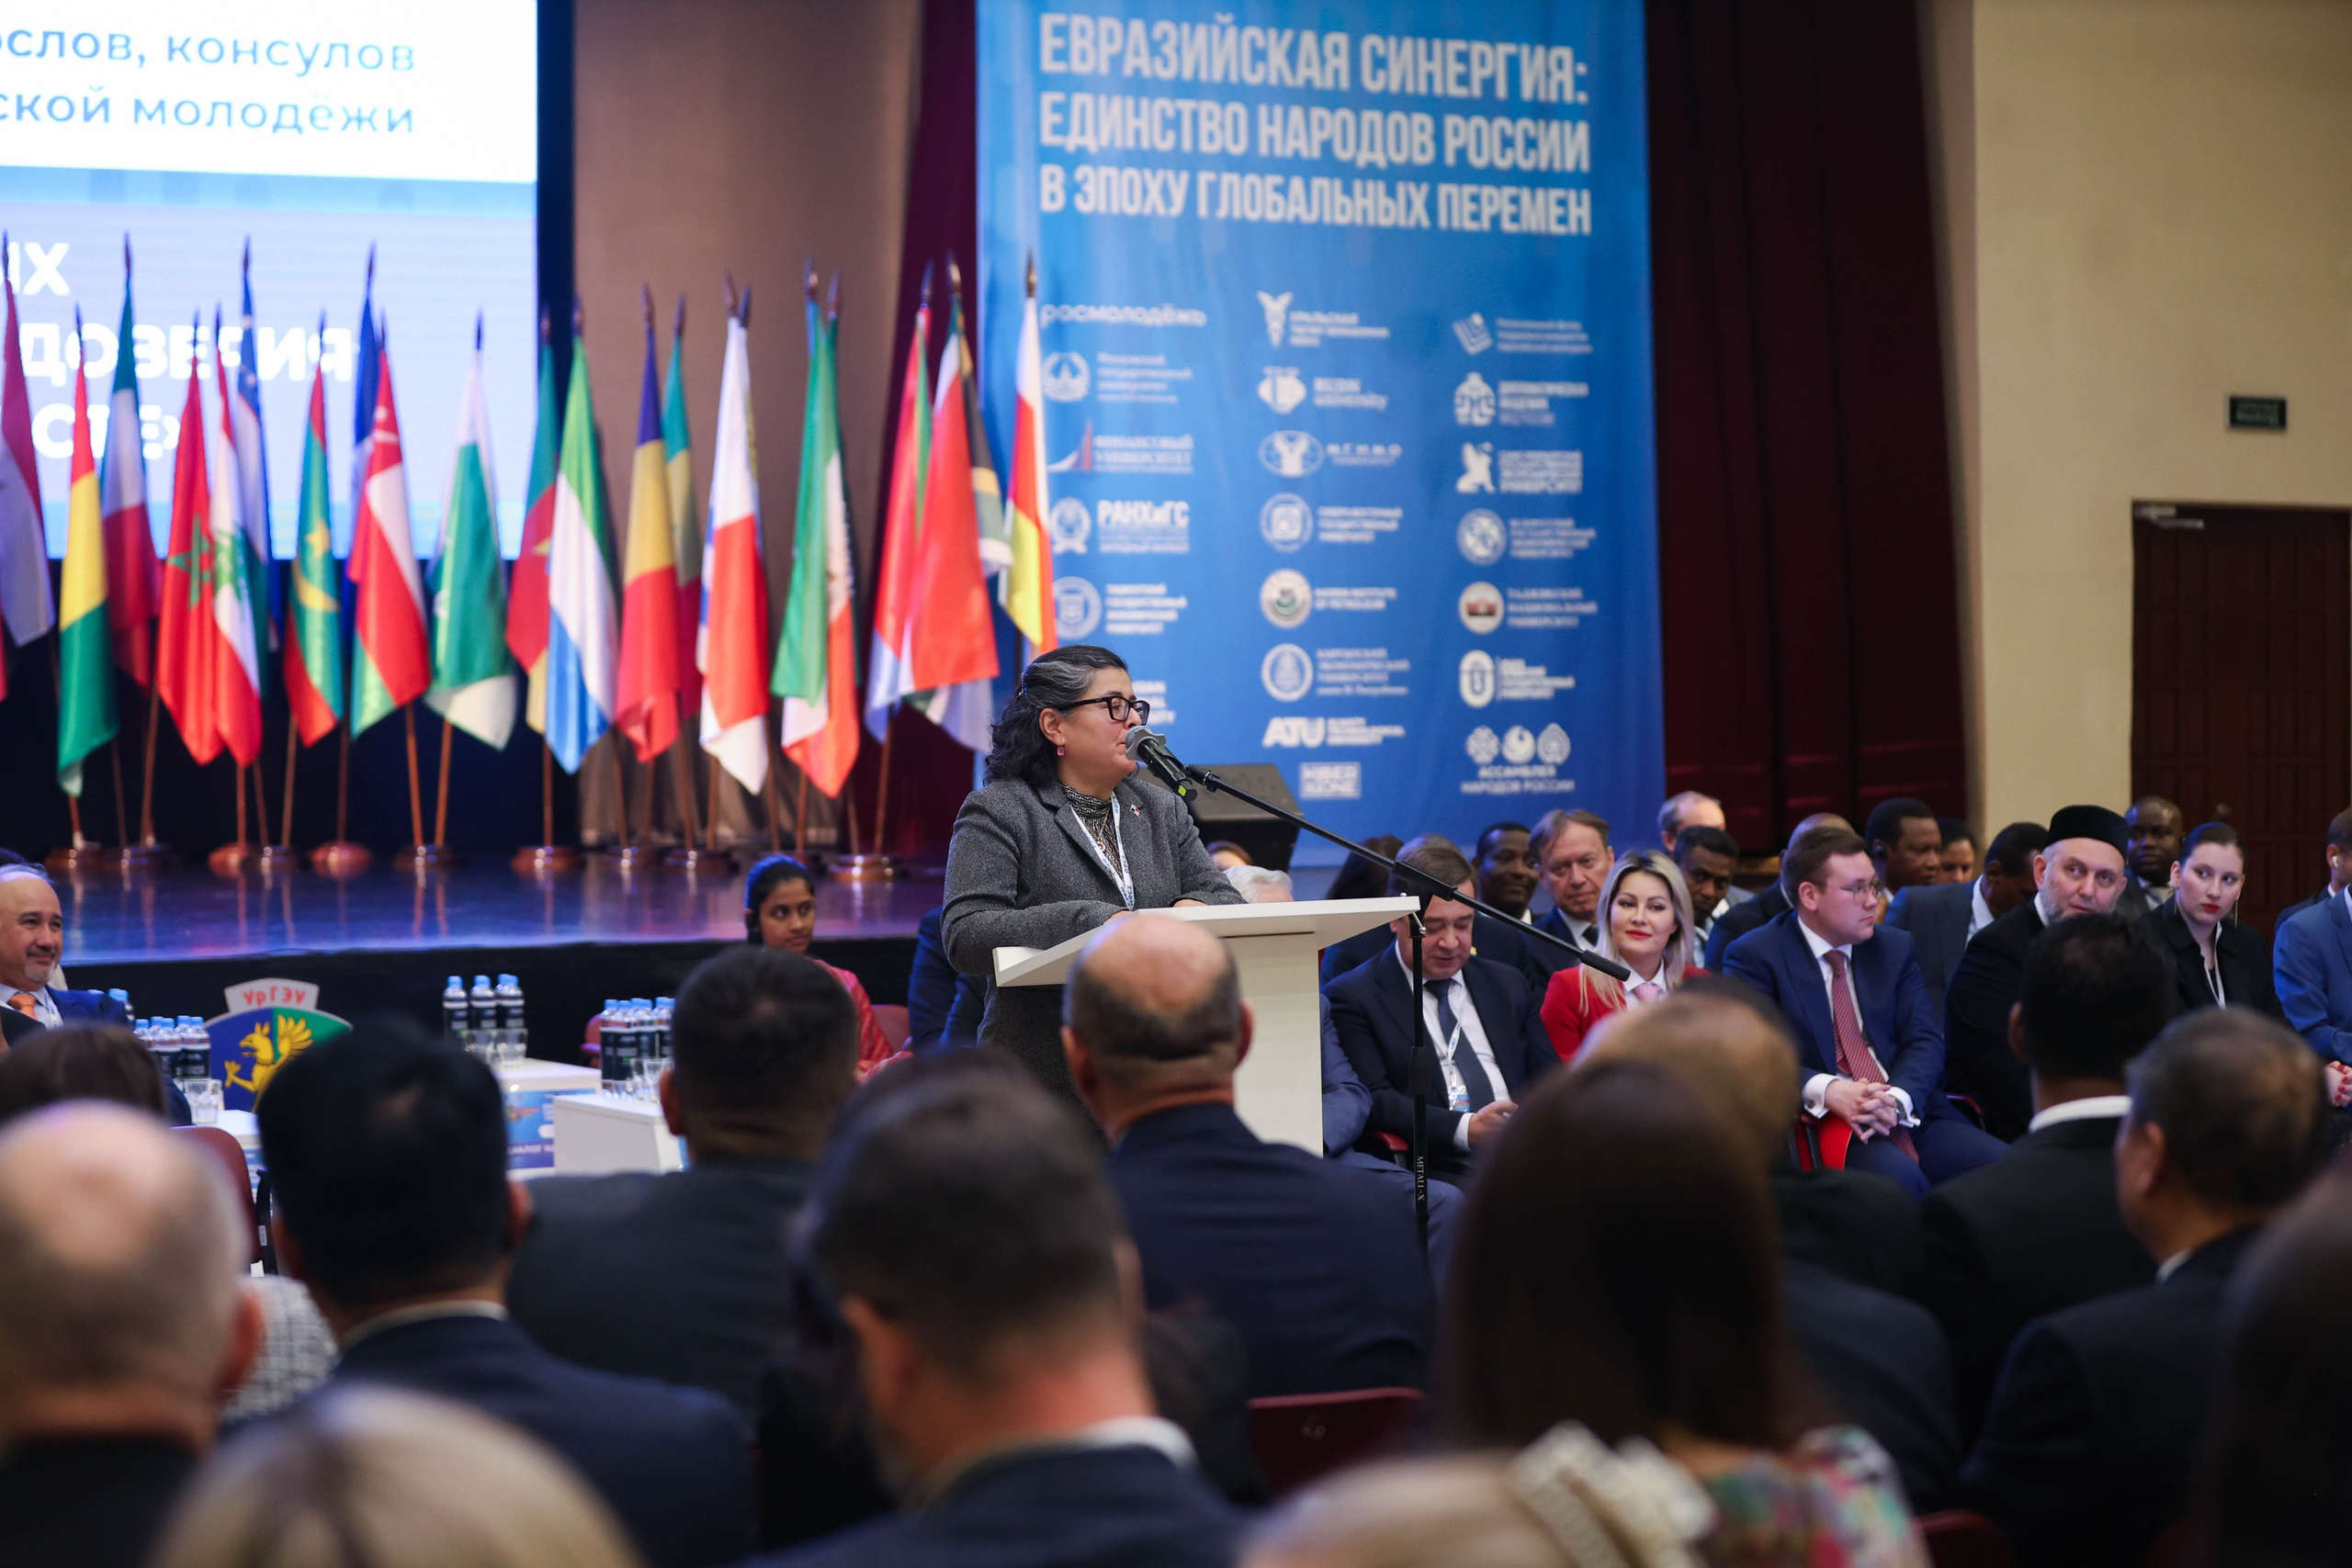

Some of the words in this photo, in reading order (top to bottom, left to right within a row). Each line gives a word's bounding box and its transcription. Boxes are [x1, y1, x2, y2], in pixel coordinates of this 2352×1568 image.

[0, 29, 145, 69] слов,
[166, 35, 415, 77] консулов
[1040, 13, 1351, 90] ЕВРАЗИЙСКАЯ
[1361, 34, 1589, 104] СИНЕРГИЯ:
[133, 94, 415, 135] молодёжи
[1040, 91, 1248, 154] ЕДИНСТВО
[1257, 103, 1435, 169] НАРОДОВ
[1443, 115, 1590, 173] РОССИИ
[1040, 164, 1066, 213] В
[1073, 165, 1189, 218] ЭПОХУ
[1197, 172, 1430, 229] ГЛОБАЛЬНЫХ
[1437, 182, 1591, 235] ПЕРЕМЕН
[1261, 716, 1326, 749] ATU
[243, 985, 307, 1007] УрГЭУ
